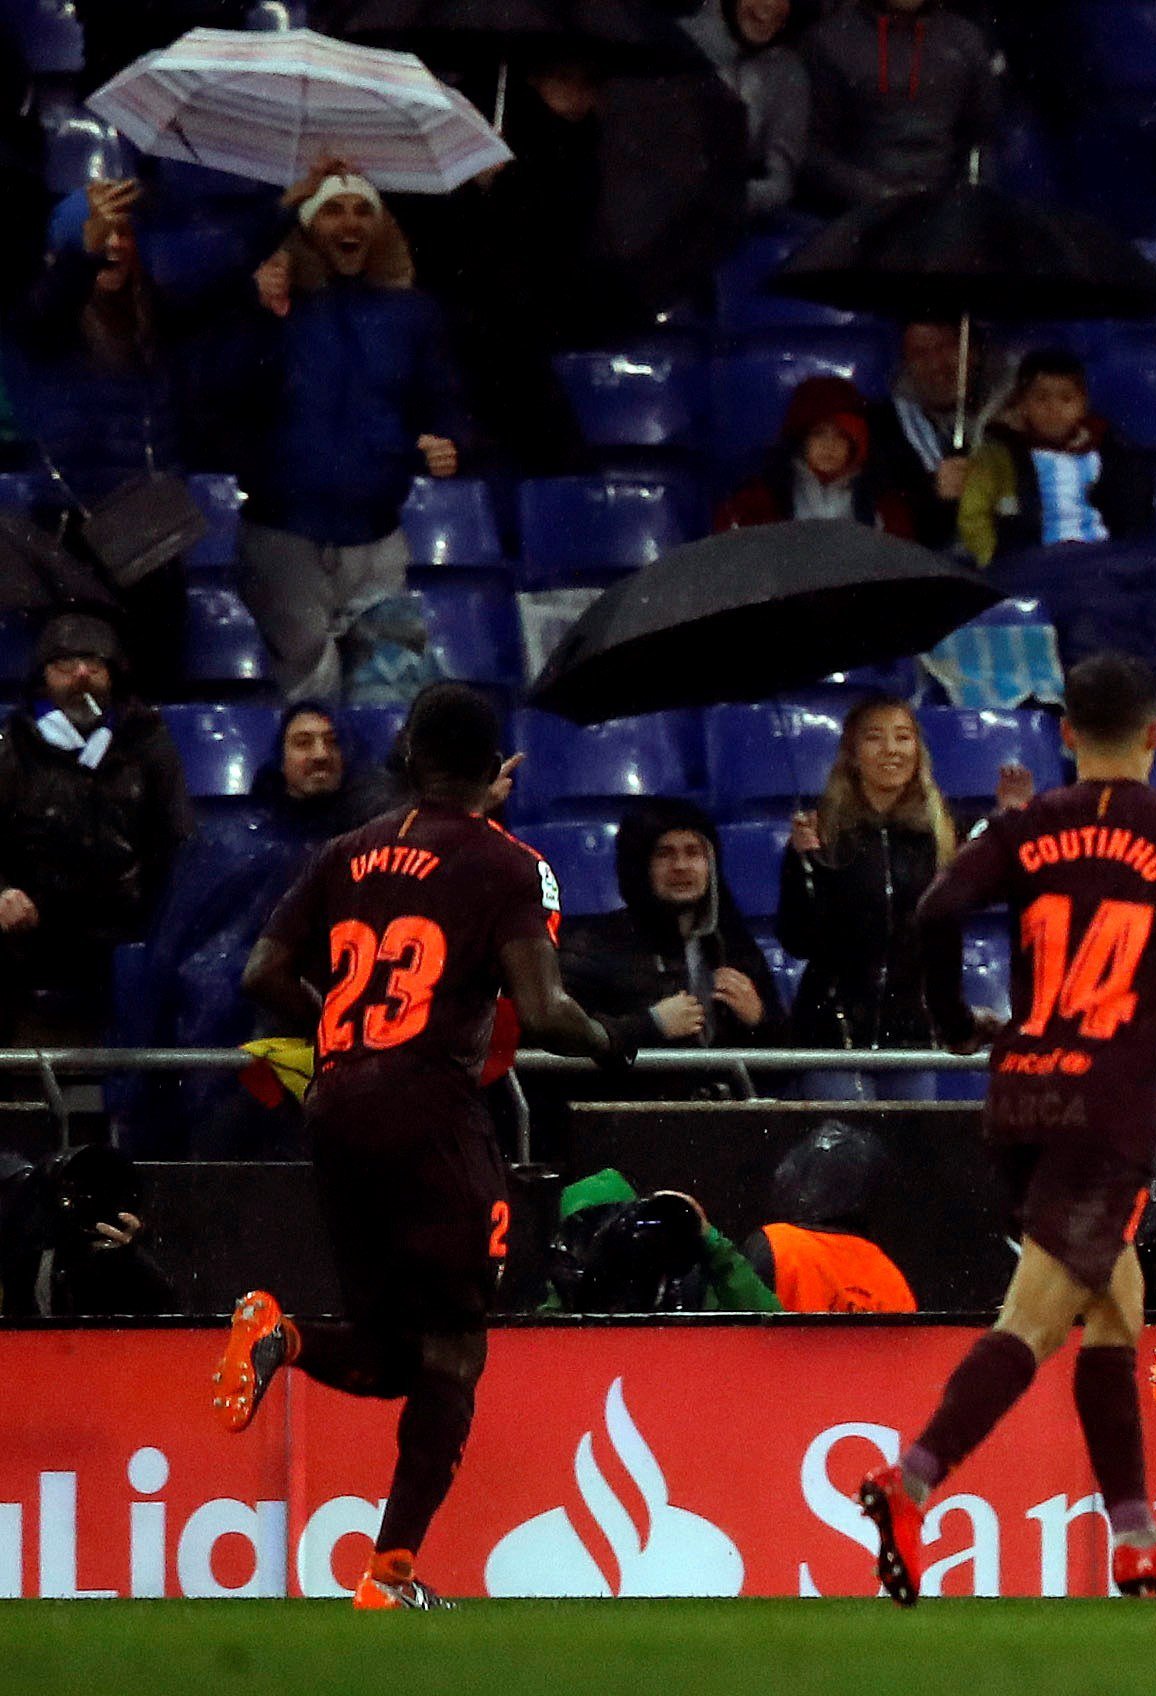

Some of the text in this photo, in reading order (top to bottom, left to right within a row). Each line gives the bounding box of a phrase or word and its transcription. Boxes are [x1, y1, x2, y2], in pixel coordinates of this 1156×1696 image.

[352, 847, 440, 882] UMTITI
[318, 916, 447, 1056] 23
[1019, 893, 1155, 1040] 14
[488, 1200, 510, 1258] 2
